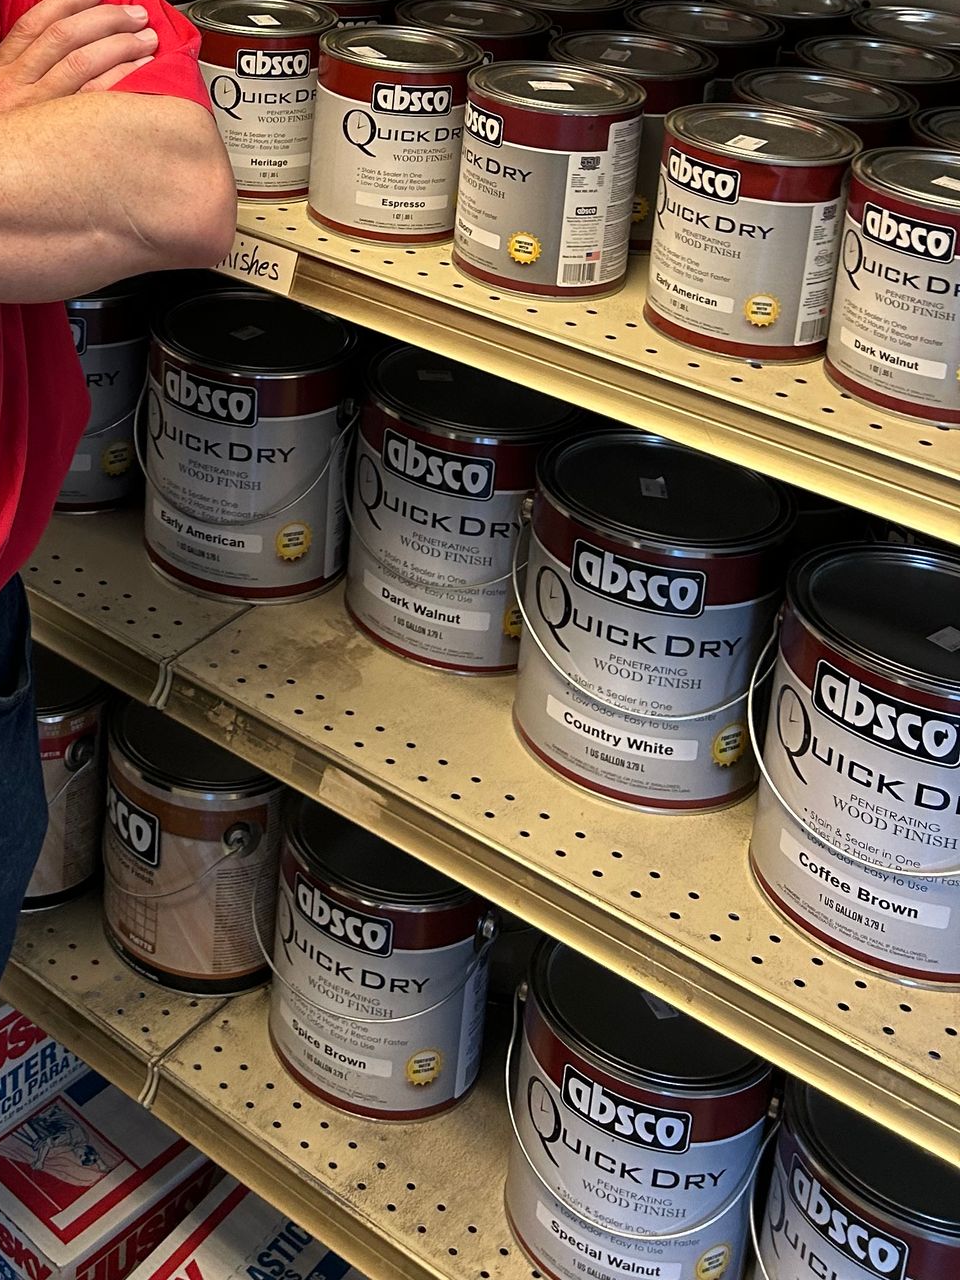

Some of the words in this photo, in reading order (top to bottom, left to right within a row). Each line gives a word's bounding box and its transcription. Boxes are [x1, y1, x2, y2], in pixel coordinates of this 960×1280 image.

[240, 50, 308, 75] absco
[210, 75, 292, 120] QUICK
[377, 84, 449, 112] absco
[342, 109, 430, 158] QUICK
[435, 127, 464, 142] DR
[465, 100, 500, 142] bsco
[250, 158, 288, 168] Heritage
[393, 154, 423, 162] WOOD
[425, 153, 453, 162] FINISH
[486, 157, 532, 183] DRY
[669, 152, 736, 198] absco
[381, 198, 426, 208] Espresso
[478, 183, 505, 199] FINISH
[657, 172, 710, 230] QUICK
[715, 215, 774, 240] DRY
[674, 232, 701, 249] WOOD
[703, 245, 741, 259] FINISH
[682, 228, 731, 248] PENETRATING
[865, 208, 950, 257] absco
[843, 228, 921, 290] QUICK
[656, 272, 670, 291] Early
[672, 284, 718, 307] American
[874, 292, 910, 312] WOOD
[912, 305, 956, 322] FINISH
[885, 288, 944, 310] PENETRATING
[854, 339, 876, 357] Dark
[879, 351, 919, 371] Walnut
[86, 370, 120, 387] RY
[165, 369, 252, 421] absco
[148, 387, 223, 460] QUICK
[228, 441, 296, 464] DRY
[387, 438, 489, 494] absco
[358, 453, 453, 531] QUICK
[160, 509, 183, 532] Early
[186, 525, 245, 549] American
[412, 531, 480, 554] PENETRATING
[400, 534, 441, 558] WOOD
[444, 551, 493, 567] FINISH
[578, 551, 699, 611] absco
[381, 587, 409, 609] Dark
[413, 602, 461, 625] Walnut
[536, 565, 657, 653] QUICK
[664, 635, 742, 659] DRY
[593, 657, 643, 683] WOOD
[647, 675, 703, 690] FINISH
[609, 653, 688, 677] PENETRATING
[563, 711, 622, 747] Country
[626, 736, 674, 756] White
[820, 673, 958, 758] absco
[776, 683, 905, 802] QUICK
[832, 794, 888, 831] WOOD
[892, 824, 959, 850] FINISH
[850, 793, 941, 834] PENETRATING
[809, 810, 833, 832] Stain
[844, 832, 879, 855] Sealer
[882, 846, 892, 859] in
[895, 853, 921, 868] One
[798, 851, 852, 894] Coffee
[857, 885, 919, 919] Brown
[298, 883, 387, 950] absco
[824, 896, 834, 909] US
[834, 902, 864, 924] GALLON
[864, 916, 880, 930] 3.79
[880, 922, 886, 933] L
[307, 976, 345, 1004] WOOD
[348, 998, 393, 1018] FINISH
[361, 969, 430, 994] DRY
[292, 1019, 320, 1048] Spice
[324, 1045, 367, 1069] Brown
[28, 1059, 70, 1096] PARA
[527, 1075, 643, 1185] QUICK
[651, 1168, 727, 1190] DRY
[568, 1082, 684, 1147] absco
[582, 1179, 630, 1209] WOOD
[634, 1204, 687, 1218] FINISH
[597, 1178, 673, 1207] PENETRATING
[793, 1168, 900, 1273] absco
[550, 1220, 602, 1261] Special
[607, 1254, 661, 1277] Walnut
